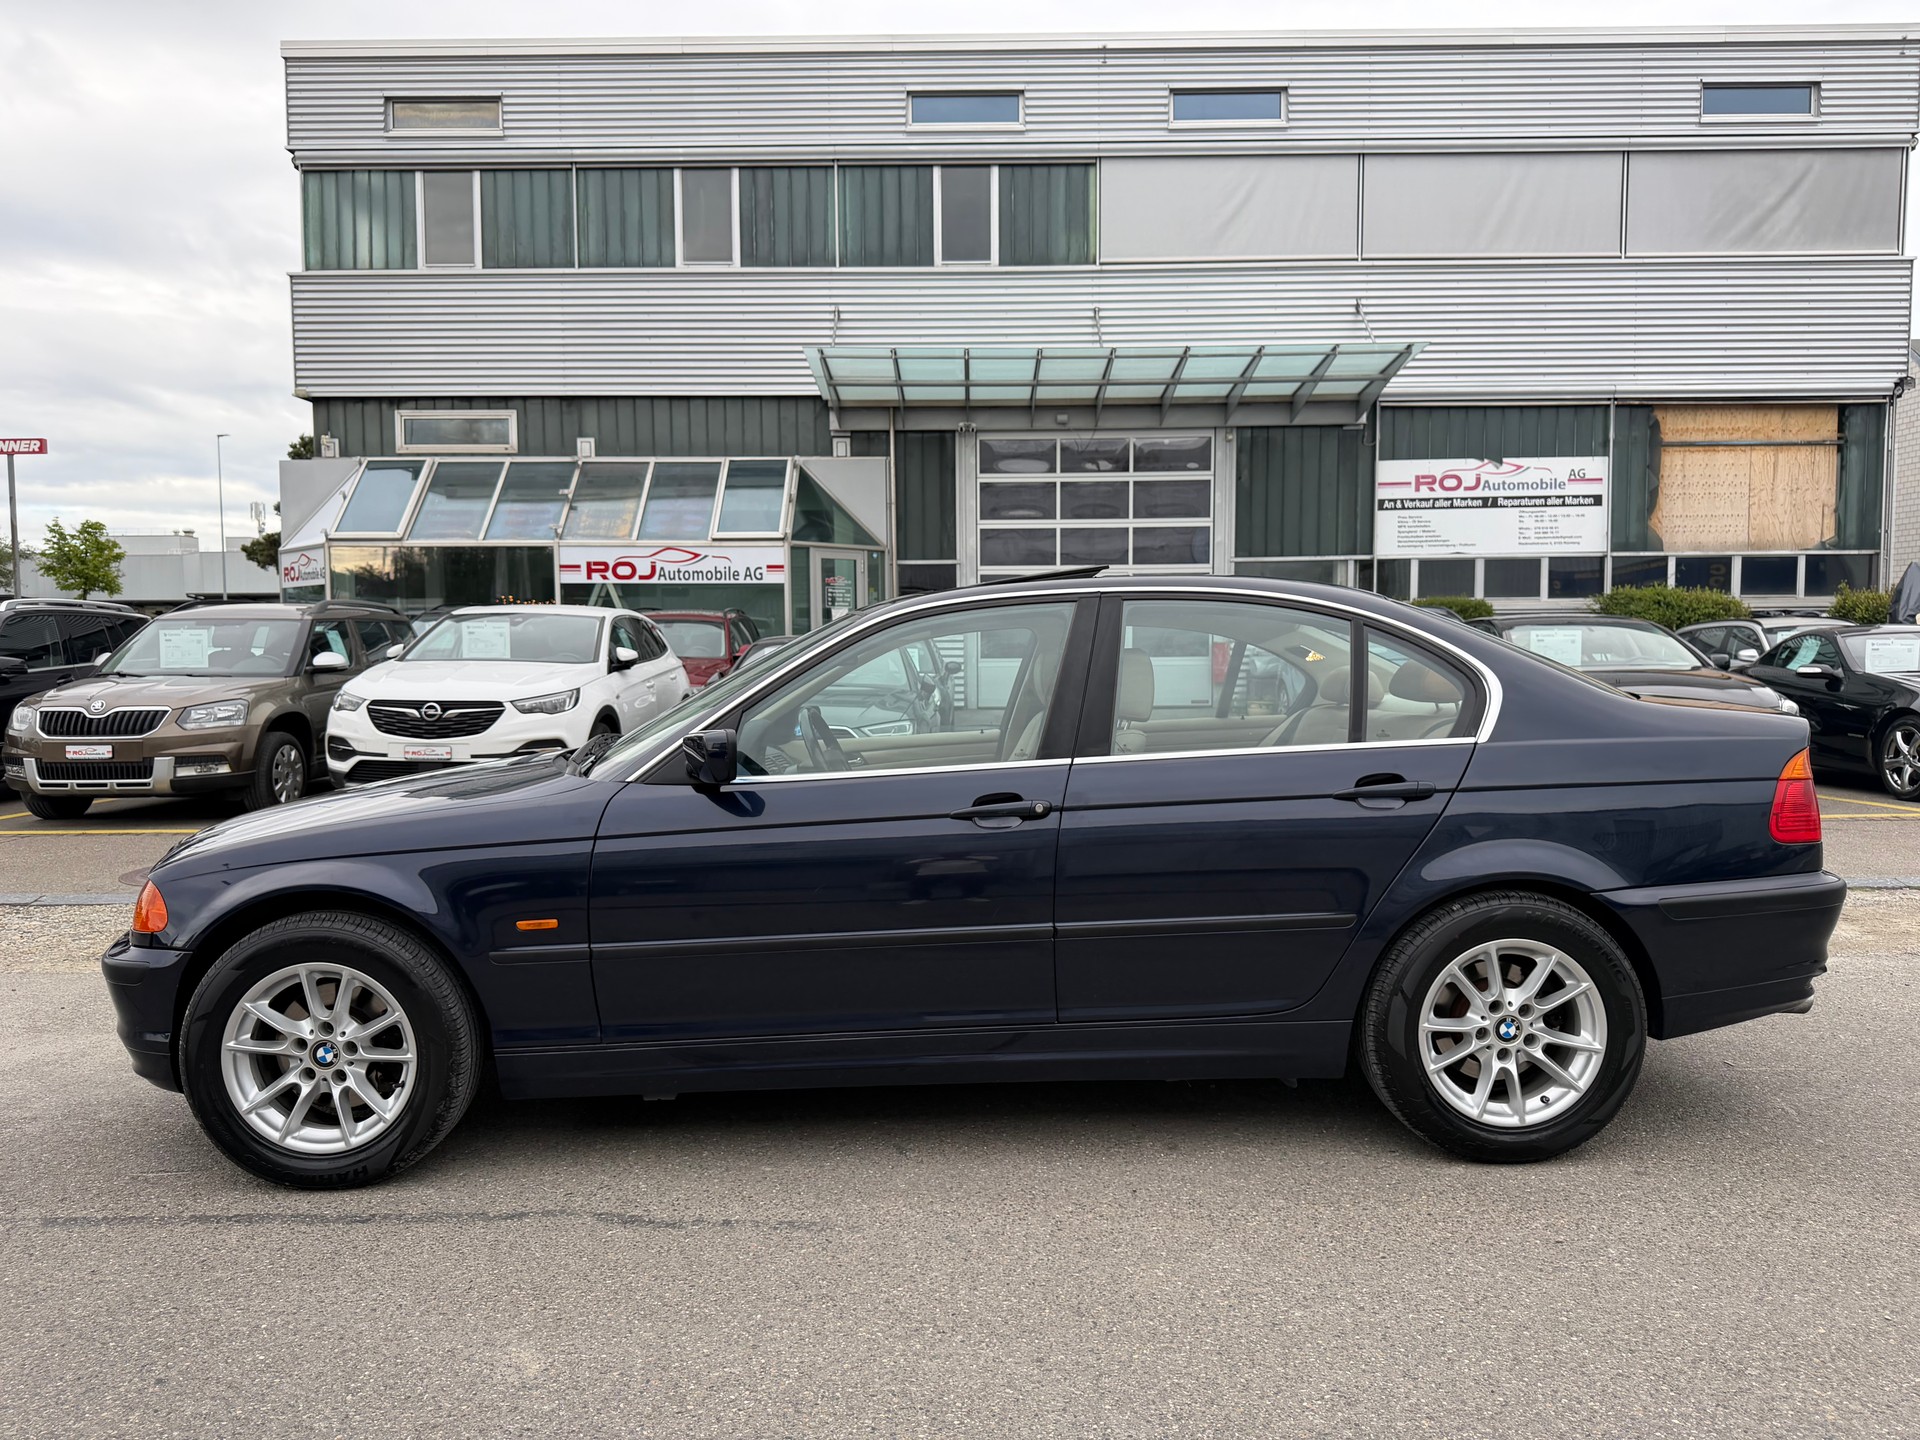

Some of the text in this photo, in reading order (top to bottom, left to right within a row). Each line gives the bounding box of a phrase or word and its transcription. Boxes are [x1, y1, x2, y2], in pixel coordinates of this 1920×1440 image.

[1414, 469, 1586, 492] ROJ Automobile AG
[1383, 500, 1394, 509] An
[1395, 500, 1402, 508] &
[1403, 498, 1433, 509] Verkauf
[1434, 498, 1451, 508] aller
[1453, 498, 1482, 508] Marken
[1497, 497, 1545, 508] Reparaturen
[1546, 497, 1563, 506] aller
[1565, 496, 1594, 505] Marken
[283, 565, 301, 583] ROJ
[586, 561, 764, 581] ROJ Automobile AG
